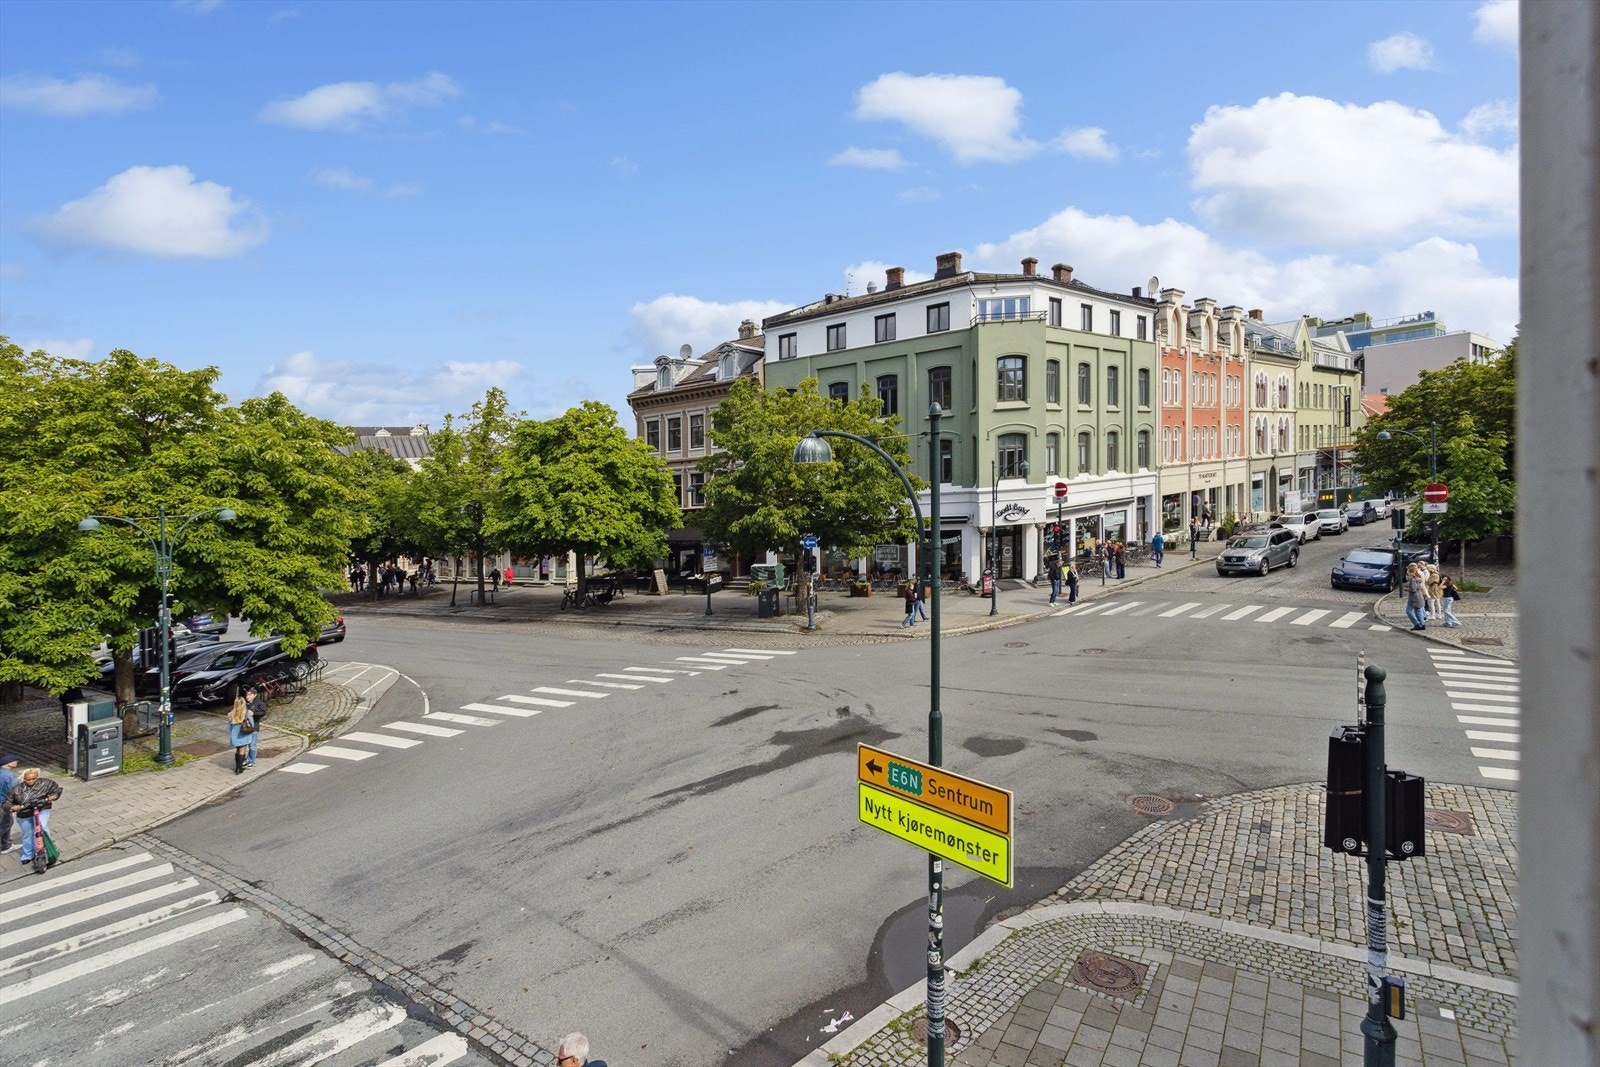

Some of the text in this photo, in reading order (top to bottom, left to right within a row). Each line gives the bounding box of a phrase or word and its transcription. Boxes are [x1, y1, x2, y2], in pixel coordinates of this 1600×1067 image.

[891, 768, 993, 816] E6N Sentrum
[865, 797, 999, 865] Nytt kjøremønster
